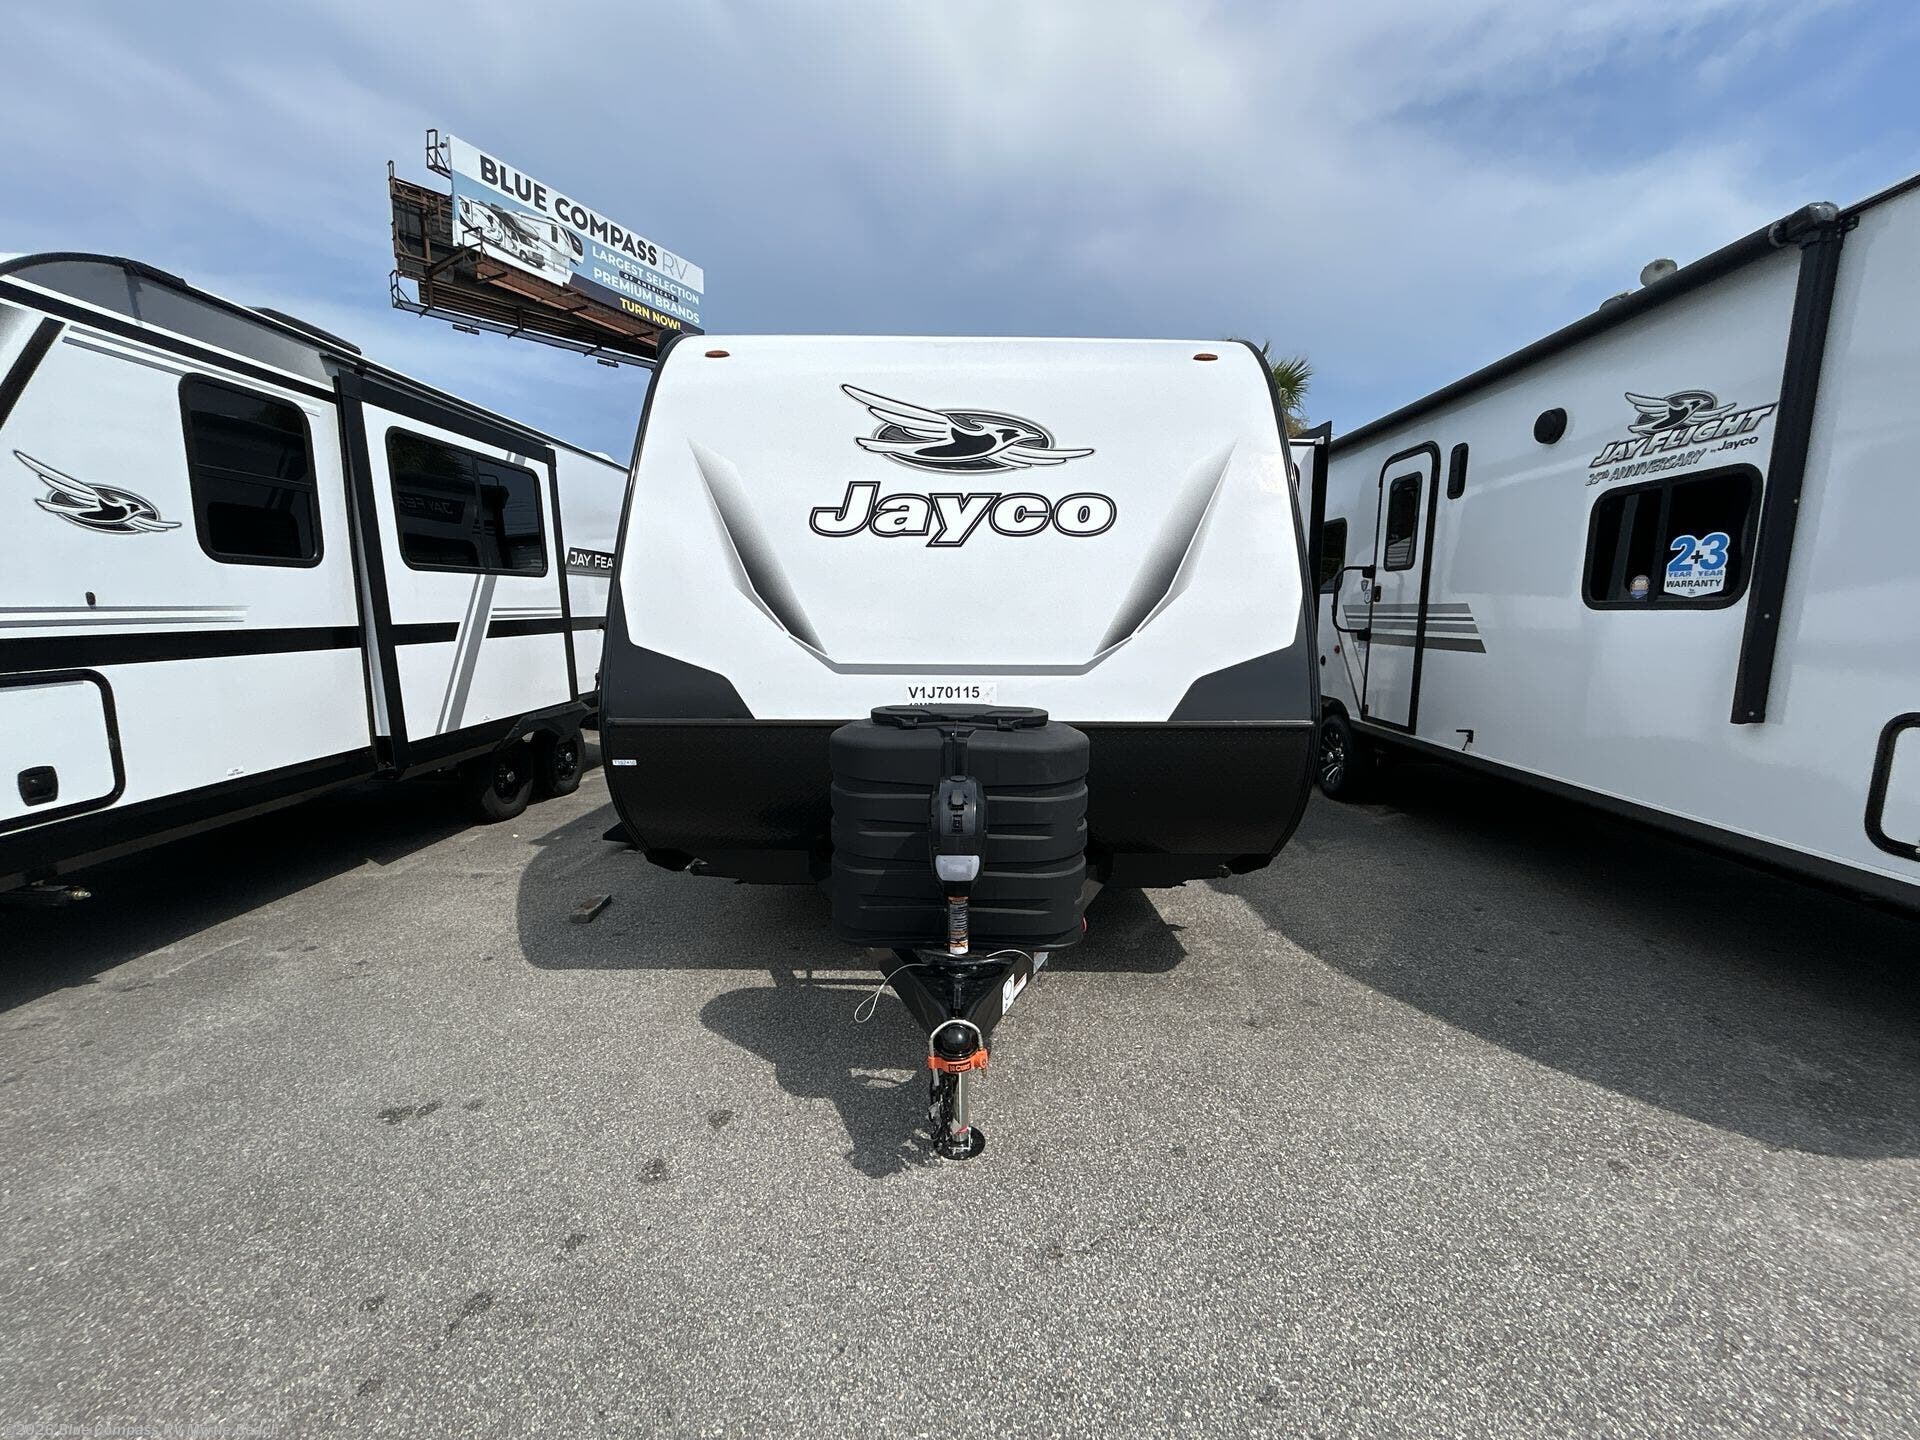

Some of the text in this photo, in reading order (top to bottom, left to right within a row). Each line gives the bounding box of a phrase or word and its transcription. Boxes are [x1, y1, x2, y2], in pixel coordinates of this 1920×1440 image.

[480, 154, 688, 280] BLUE COMPASS RV
[592, 246, 699, 305] LARGEST SELECTION
[593, 267, 700, 324] PREMIUM BRANDS
[620, 297, 681, 330] TURN NOW!
[1717, 436, 1759, 451] Jayco
[1609, 448, 1708, 481] ANNIVERSARY
[808, 480, 1117, 548] Jayco
[570, 551, 613, 568] JAY FEA
[908, 686, 980, 699] V1J70115
